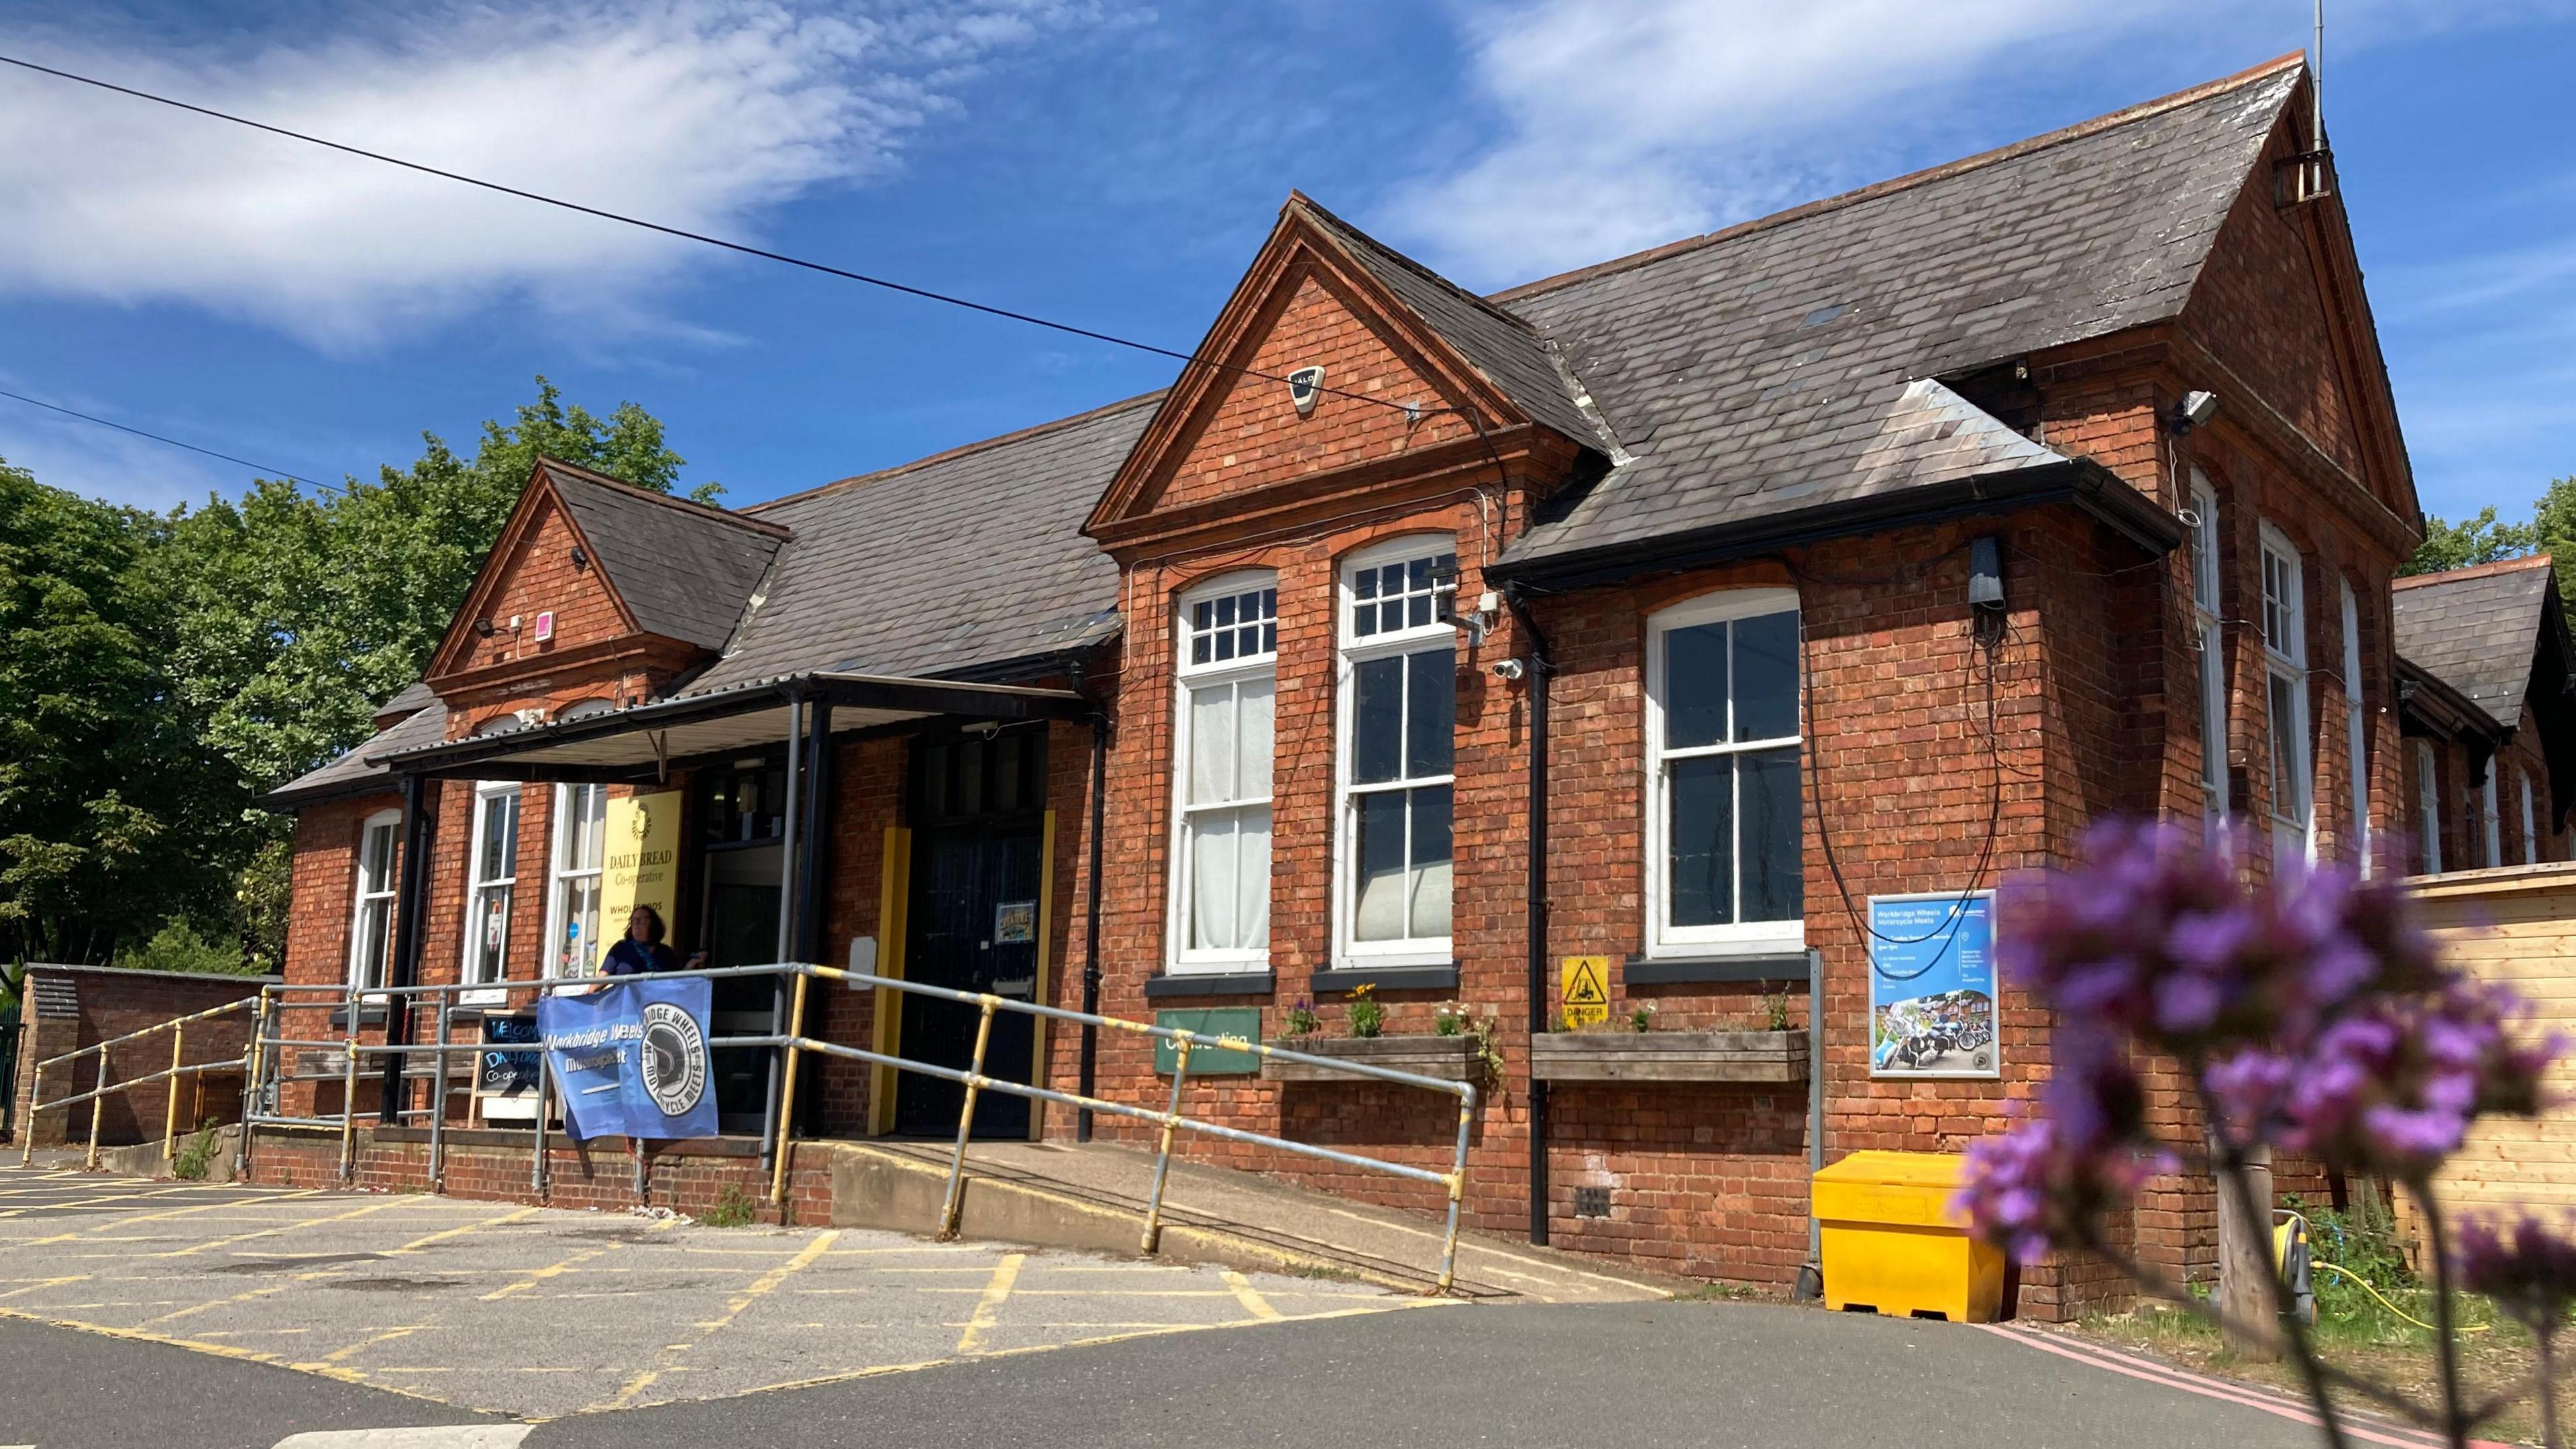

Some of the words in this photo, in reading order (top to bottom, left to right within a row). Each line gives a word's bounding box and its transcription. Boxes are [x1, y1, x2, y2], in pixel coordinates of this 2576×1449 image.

[1292, 375, 1313, 384] ALO
[610, 853, 638, 869] DAILY
[640, 850, 672, 866] BREAD
[614, 869, 663, 887] Co-operative
[1566, 1007, 1603, 1016] DANGER
[492, 1020, 541, 1040] WELCOM
[672, 1012, 700, 1054] WHEELS
[684, 1065, 702, 1104] MEETS
